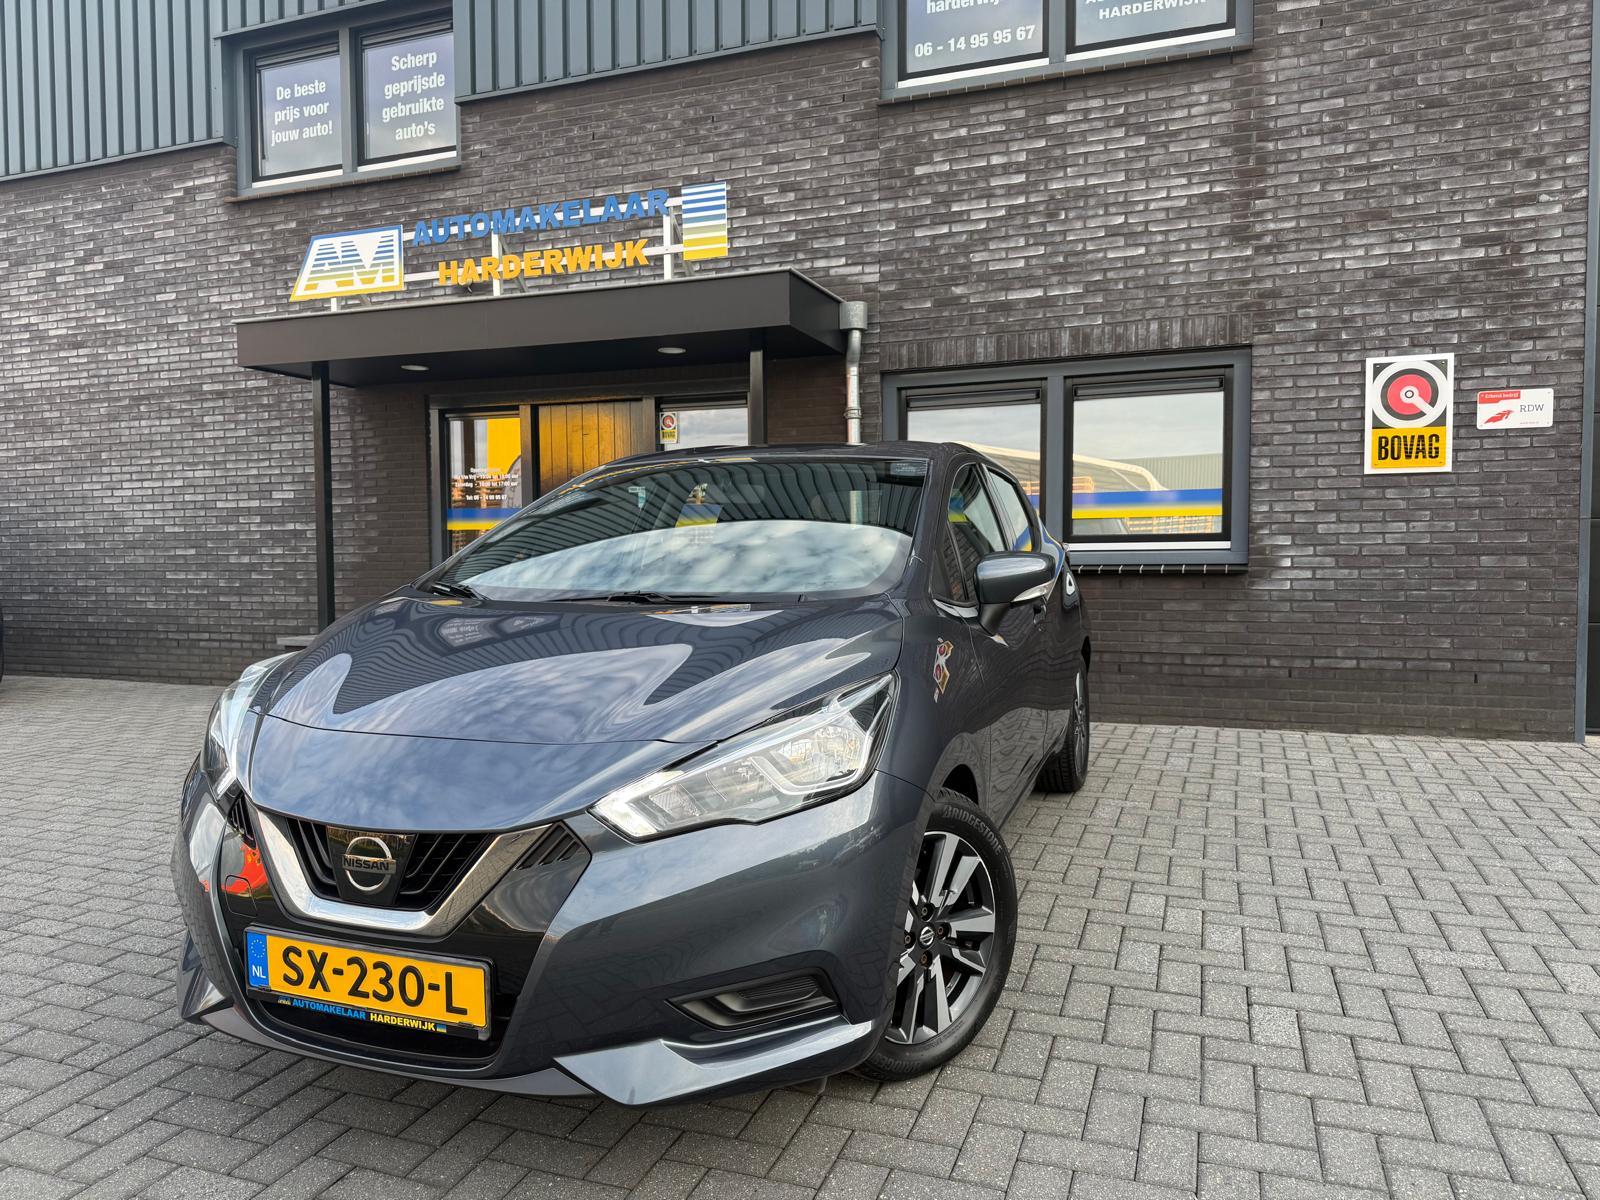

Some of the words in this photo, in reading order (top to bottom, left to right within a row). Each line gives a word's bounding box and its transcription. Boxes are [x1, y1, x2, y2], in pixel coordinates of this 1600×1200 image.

[1099, 0, 1206, 19] HARDERWIJ
[914, 42, 933, 57] 06
[947, 36, 966, 52] 14
[969, 32, 989, 49] 95
[992, 28, 1012, 45] 95
[1016, 25, 1036, 41] 67
[391, 51, 437, 71] Scherp
[276, 86, 291, 101] De
[294, 79, 326, 98] beste
[384, 72, 446, 99] geprijsde
[274, 106, 300, 125] prijs
[302, 102, 330, 117] voor
[382, 96, 445, 123] gebruikte
[271, 129, 299, 146] jouw
[302, 120, 333, 139] auto!
[395, 120, 436, 141] auto's
[412, 189, 670, 248] AUTOMAKELAAR
[438, 239, 650, 286] HARDERWIJK
[1519, 404, 1545, 413] RDW
[1378, 433, 1440, 461] BOVAG
[943, 804, 1001, 854] BRIDGESTONE
[343, 857, 389, 871] NISSAN
[252, 964, 267, 979] NL
[281, 945, 468, 1015] SX-230-L
[292, 998, 366, 1020] AUTOMAKELAAR
[370, 1012, 436, 1032] HARDERWIJK
